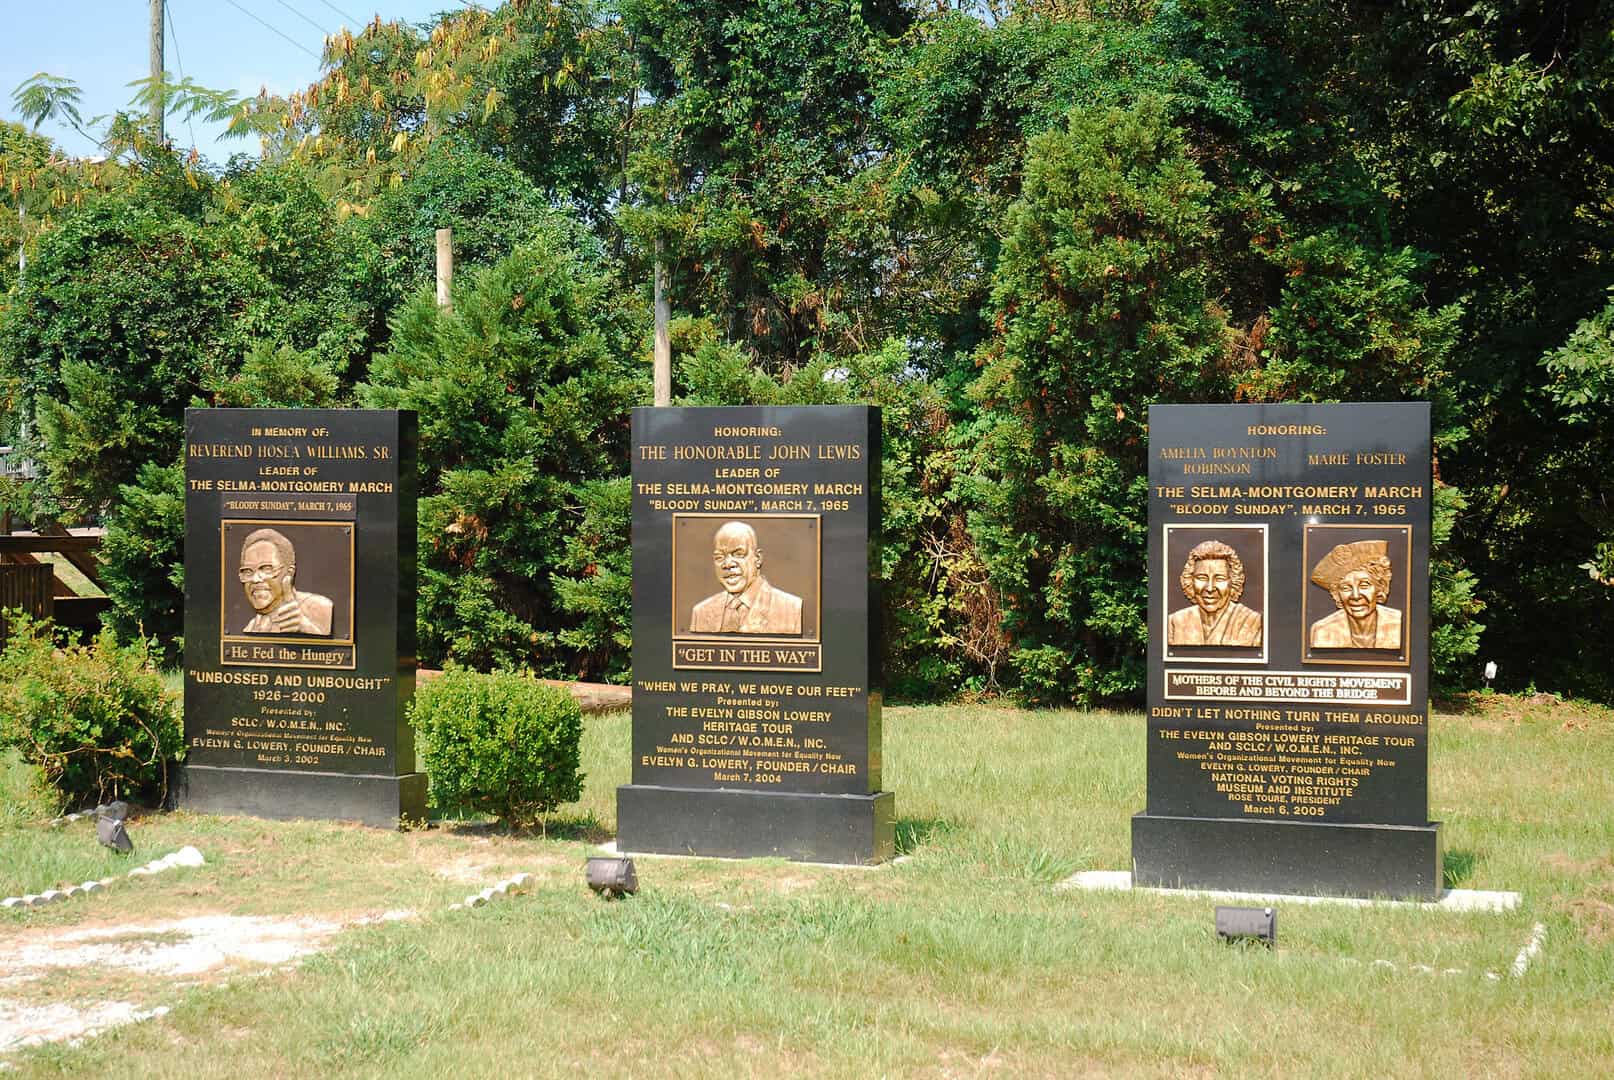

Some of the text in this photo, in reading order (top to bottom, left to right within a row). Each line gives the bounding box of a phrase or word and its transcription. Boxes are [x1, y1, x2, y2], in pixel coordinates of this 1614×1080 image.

[251, 428, 329, 437] IN MEMORY OF:
[715, 427, 782, 437] HONORING:
[1248, 425, 1328, 436] HONORING:
[190, 444, 253, 458] REVEREND
[640, 445, 861, 460] THE HONORABLE JOHN LEWIS
[1160, 447, 1277, 459] AMELIA BOYNTON
[1308, 453, 1407, 465] MARIE FOSTER
[259, 467, 318, 476] LEADER OF
[715, 468, 781, 478] LEADER OF
[1183, 463, 1251, 475] ROBINSON
[190, 480, 393, 493] THE SELMA-MONTGOMERY MARCH
[637, 483, 863, 495] THE SELMA-MONTGOMERY MARCH
[1156, 486, 1422, 498] THE SELMA-MONTGOMERY MARCH
[298, 502, 326, 511] MARCH
[649, 500, 700, 510] "BLOODY
[761, 501, 802, 510] MARCH
[806, 501, 817, 511] 7,
[821, 501, 849, 511] 1965
[1170, 504, 1230, 516] "BLOODY
[1302, 505, 1350, 516] MARCH
[1373, 505, 1406, 516] 1965
[231, 647, 345, 665] He Fed the Hungry
[678, 648, 816, 664] "GET IN THE WAY"
[190, 670, 391, 690] "UNBOSSED AND UNBOUGHT"
[1172, 675, 1403, 689] MOTHERS OF THE CIVIL RIGHTS MOVEMENT
[638, 681, 861, 697] "WHEN WE PRAY, WE MOVE OUR FEET"
[1196, 686, 1377, 699] BEFORE AND BEYOND THE BRIDGE
[717, 697, 779, 709] Presented by:
[666, 707, 832, 722] THE EVELYN GIBSON LOWERY
[1152, 707, 1423, 725] DIDN'T LET NOTHING TURN THEM AROUND!
[231, 718, 259, 727] SCLC
[703, 722, 793, 734] HERITAGE TOUR
[1255, 722, 1299, 732] Presented
[671, 734, 694, 744] AND
[698, 735, 728, 745] SCLC
[804, 738, 827, 749] INC.
[1159, 730, 1415, 747] THE EVELYN GIBSON LOWERY HERITAGE TOUR
[193, 738, 386, 757] EVELYN G. FOUNDER CHAIR
[1208, 741, 1362, 756] AND SCLC INC.
[257, 754, 282, 762] March
[296, 755, 320, 764] 2002
[1279, 755, 1321, 764] Movement
[1324, 756, 1337, 765] for
[1339, 757, 1374, 767] Equality
[642, 756, 857, 775] EVELYN G. LOWERY, FOUNDER CHAIR
[1201, 762, 1234, 771] EVELYN
[1292, 765, 1334, 774] FOUNDER
[1341, 766, 1371, 776] CHAIR
[714, 772, 741, 782] March
[755, 774, 782, 784] 2004
[1211, 773, 1359, 787] NATIONAL VOTING RIGHTS
[1216, 783, 1353, 797] MUSEUM AND INSTITUTE
[1228, 794, 1252, 802] ROSE
[1290, 795, 1341, 806] PRESIDENT
[1244, 804, 1275, 815] March
[1294, 806, 1325, 816] 2005
